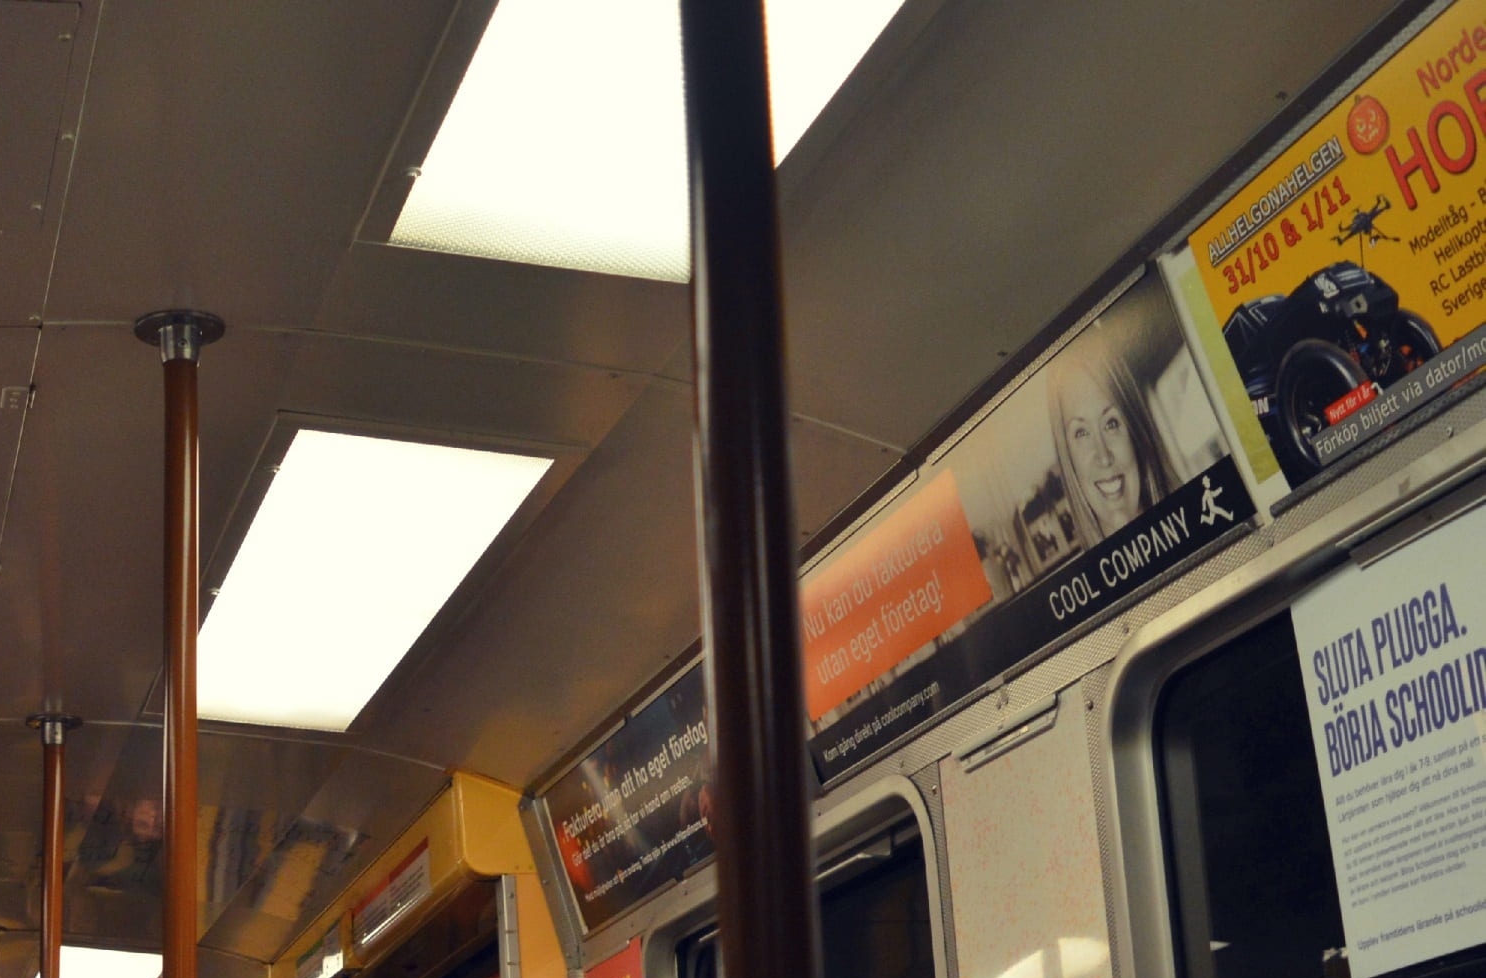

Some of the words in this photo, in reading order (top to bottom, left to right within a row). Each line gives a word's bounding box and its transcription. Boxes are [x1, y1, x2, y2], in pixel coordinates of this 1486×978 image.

[1207, 134, 1345, 264] ALLHELGONAHELGEN
[1222, 231, 1280, 295] 31/10
[1280, 216, 1302, 248] &
[1300, 175, 1352, 232] 1/11
[1408, 203, 1469, 256] Modelltåg
[1429, 271, 1451, 297] RC
[1315, 424, 1360, 459] Förköp
[1359, 393, 1401, 431] biljett
[1401, 381, 1424, 404] via
[801, 608, 827, 645] Nu
[821, 587, 854, 629] kan
[851, 576, 874, 606] du
[871, 519, 945, 590] fakturera
[1049, 571, 1102, 621] COOL
[1098, 505, 1191, 589] COMPANY
[816, 642, 851, 686] utan
[849, 616, 885, 664] eget
[880, 567, 946, 638] företag!
[1312, 627, 1375, 707] SLUTA
[1370, 581, 1469, 677] PLUGGA.
[822, 746, 839, 763] Kom
[835, 736, 858, 757] igång
[854, 722, 874, 744] direkt
[871, 714, 883, 736] på
[880, 680, 942, 727] coolcompany.com
[1323, 698, 1388, 779] BÖRJA
[1393, 767, 1406, 781] dig
[1457, 738, 1469, 755] på
[562, 802, 604, 843] Fakturera
[620, 771, 636, 799] att
[633, 766, 650, 788] ha
[646, 743, 672, 779] eget
[668, 720, 708, 761] företag
[643, 794, 662, 816] hand
[659, 790, 672, 805] om
[669, 774, 693, 798] resten.
[1408, 780, 1421, 794] dig
